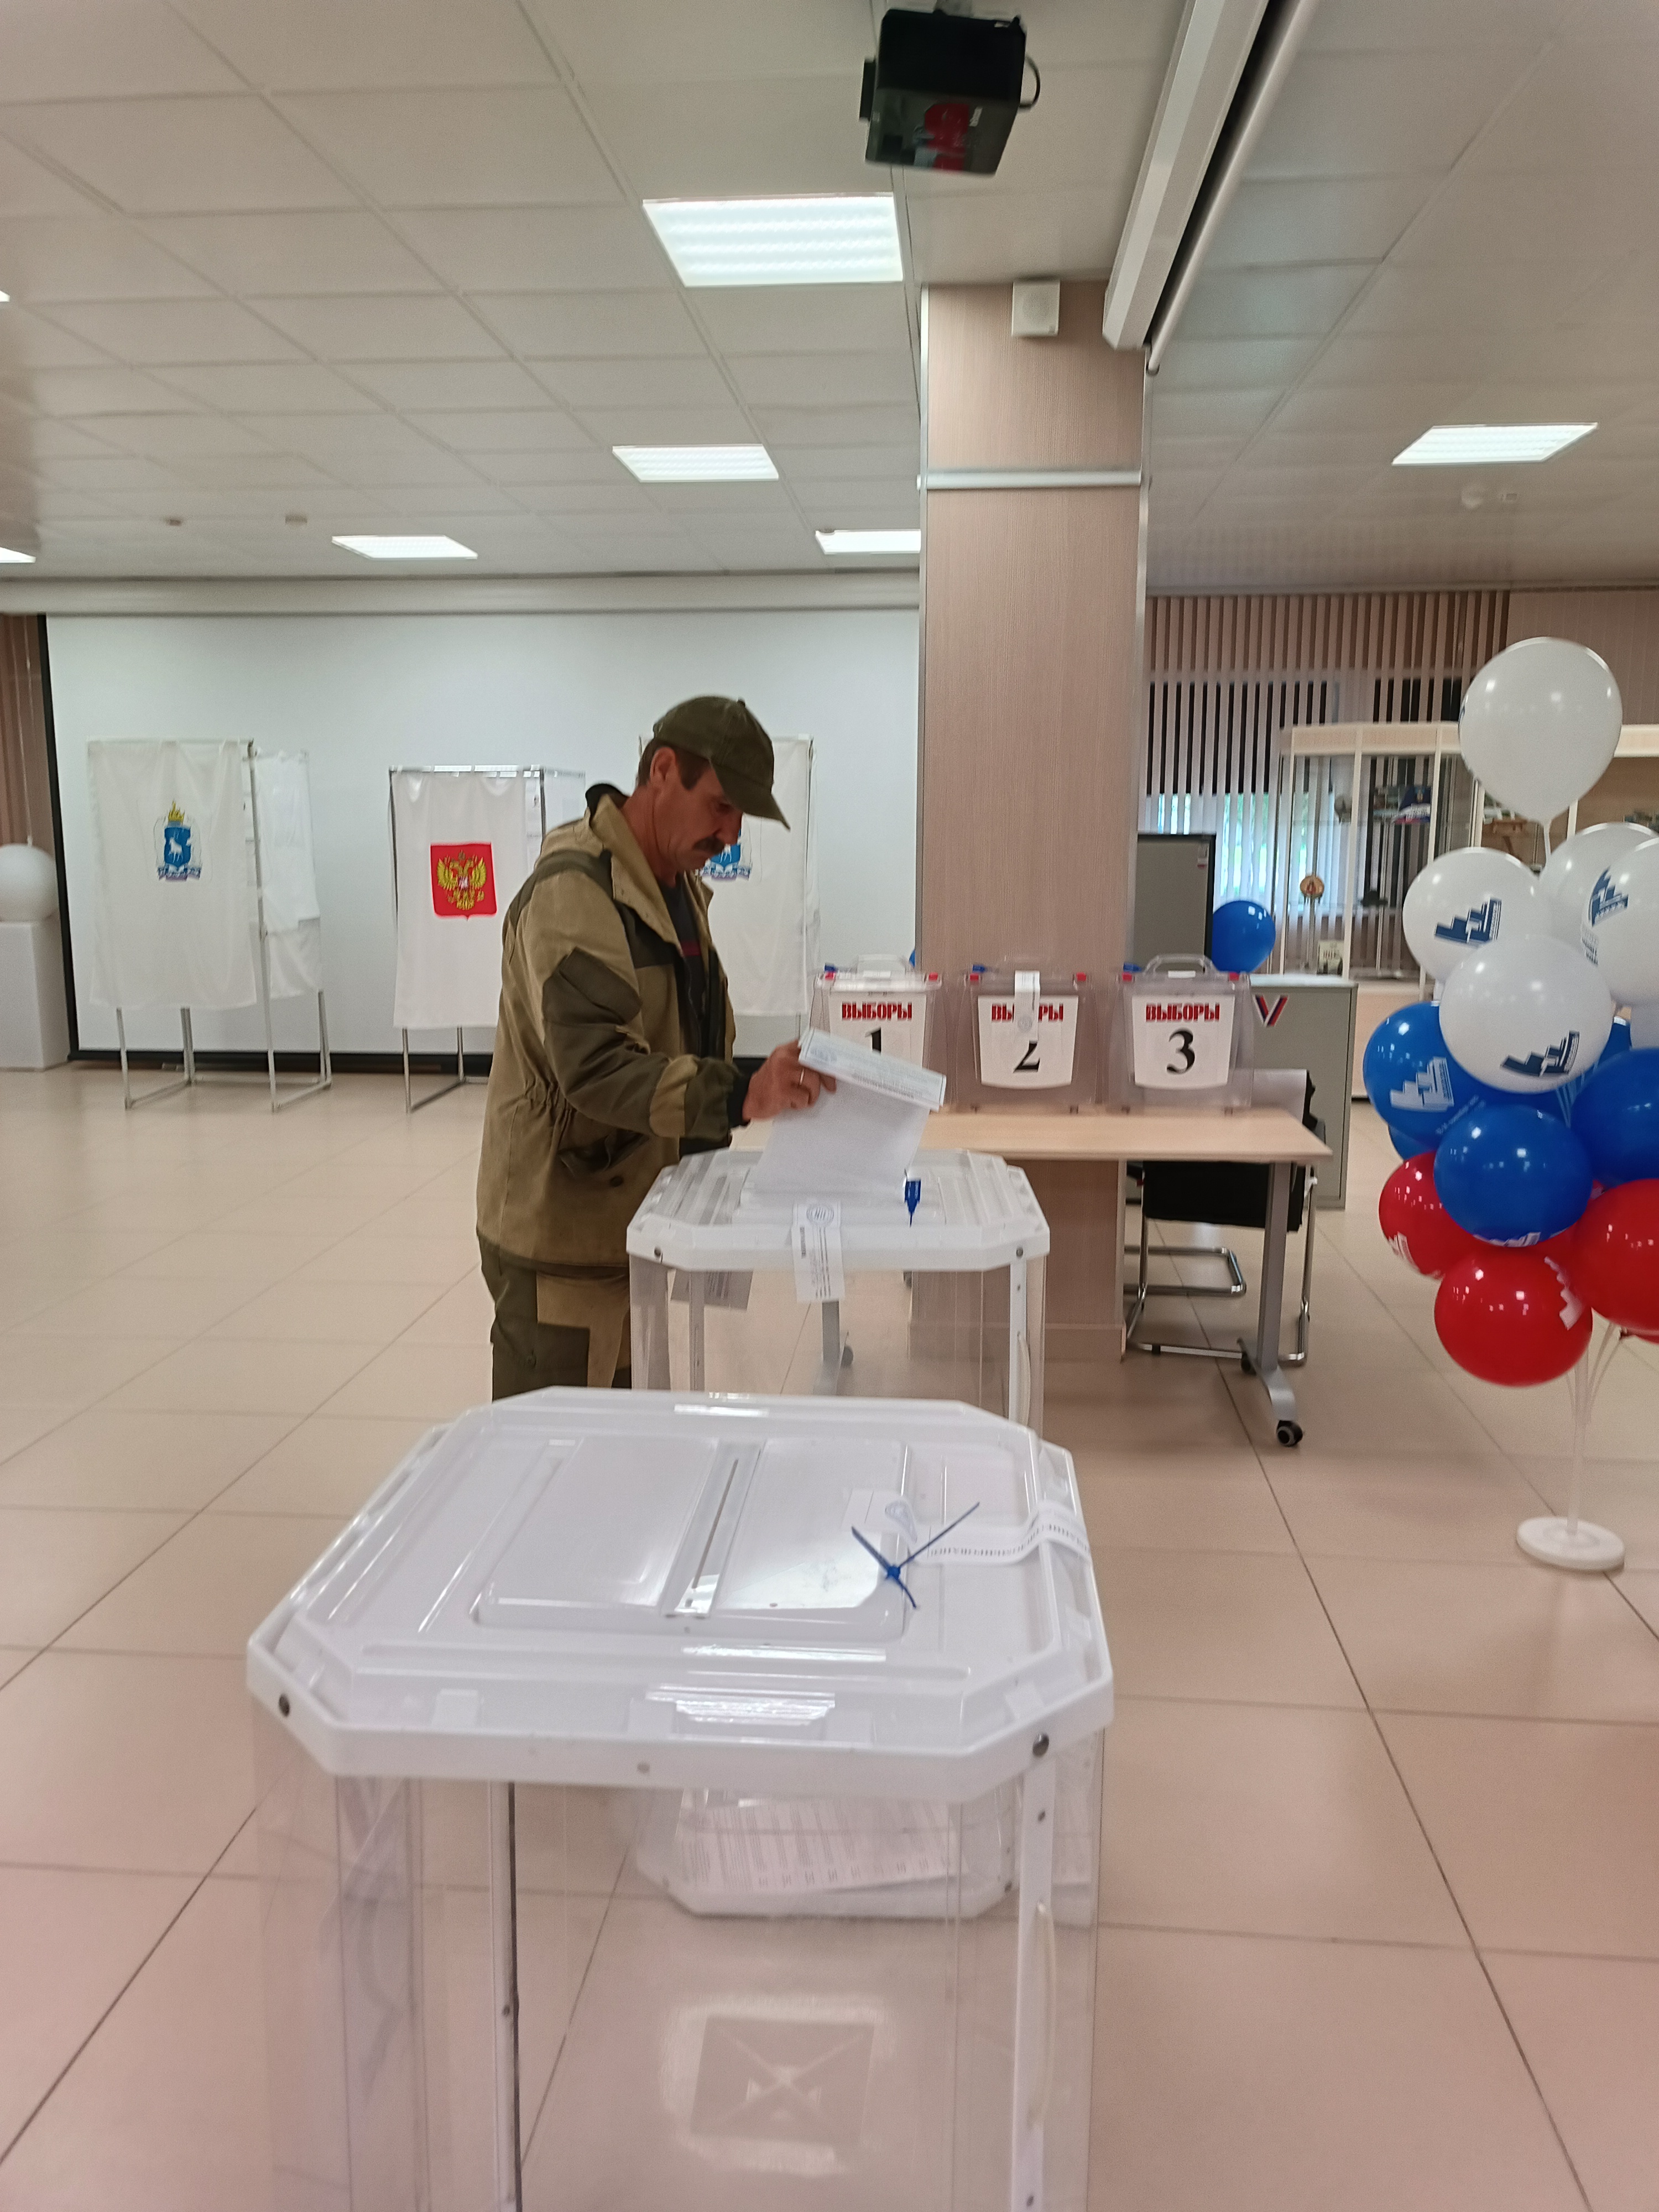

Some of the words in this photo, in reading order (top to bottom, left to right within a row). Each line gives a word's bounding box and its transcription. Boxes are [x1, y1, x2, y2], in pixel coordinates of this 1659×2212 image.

[842, 1002, 912, 1021] ВЫБОРЫ
[992, 1004, 1064, 1022] ВЫРЫ
[1146, 1003, 1220, 1022] ВЫБОРЫ
[1166, 1027, 1196, 1074] 3
